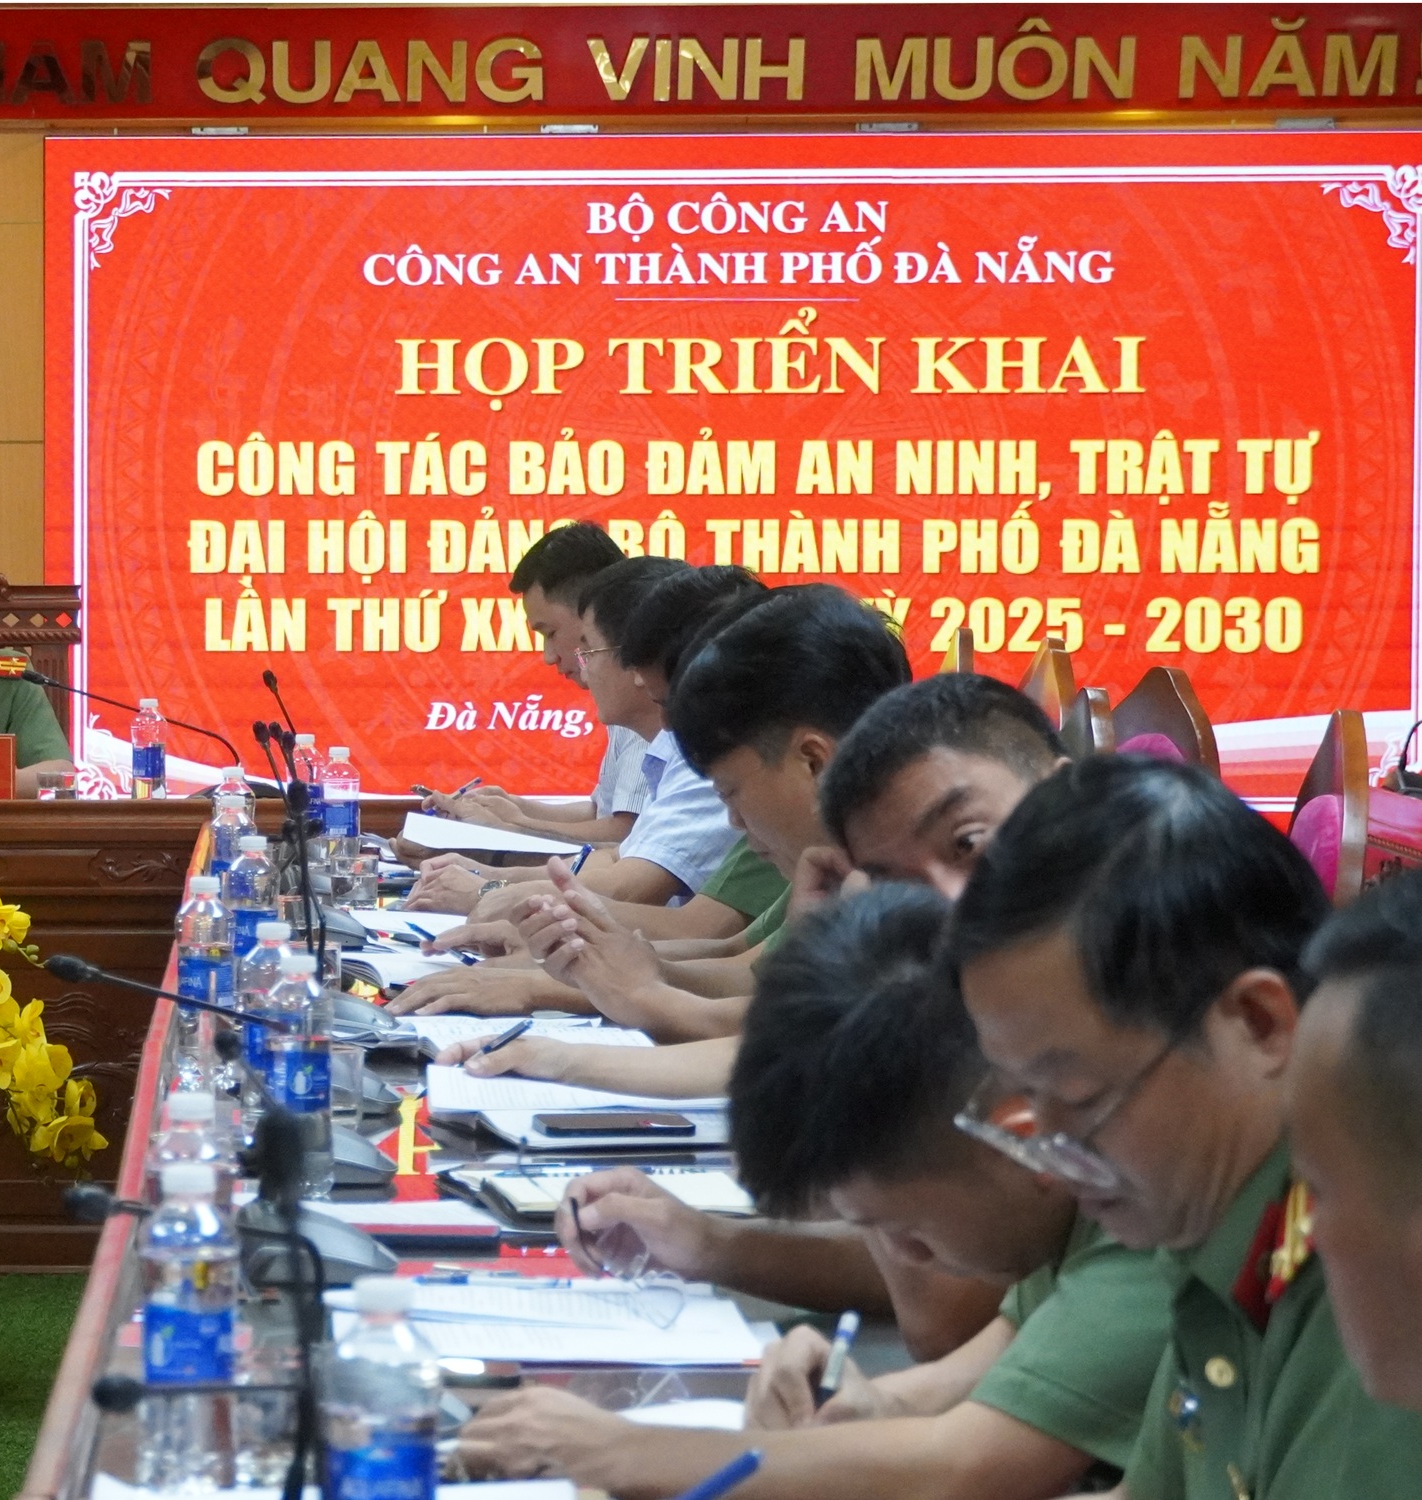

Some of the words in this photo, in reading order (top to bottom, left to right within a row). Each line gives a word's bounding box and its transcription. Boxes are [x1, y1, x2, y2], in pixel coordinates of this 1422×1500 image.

[195, 37, 544, 104] QUANG
[587, 36, 805, 102] VINH
[854, 17, 1137, 102] MUÔN
[1178, 16, 1399, 98] NĂM
[586, 191, 655, 246] BỘ
[667, 191, 809, 234] CÔNG
[819, 200, 889, 233] AN
[363, 243, 503, 286] CÔNG
[514, 252, 583, 285] AN
[594, 242, 768, 285] THÀNH
[778, 236, 883, 284] PHỐ
[893, 241, 962, 284] ĐÀ
[974, 235, 1115, 284] NẴNG
[394, 337, 585, 411] HỌP
[608, 305, 886, 395] TRIỂN
[910, 335, 1146, 394] KHAI
[196, 431, 356, 497] CÔNG
[375, 431, 487, 497] TÁC
[508, 426, 625, 496] BẢO
[644, 426, 776, 495] ĐẢM
[795, 439, 873, 495] AN
[895, 439, 1052, 506] NINH,
[1069, 430, 1220, 507] TRẬT
[1235, 430, 1321, 507] TỰ
[186, 519, 285, 585] ĐẠI
[307, 509, 407, 586] HỘI
[426, 505, 578, 574] ĐẢN
[705, 509, 900, 574] THÀNH
[922, 500, 1040, 575] PHỐ
[1059, 509, 1141, 574] ĐÀ
[1158, 500, 1320, 575] NẴNG
[204, 577, 307, 652] LẦN
[326, 584, 449, 653] THỨ
[930, 596, 1084, 653] 2025
[1103, 623, 1126, 636] -
[1145, 596, 1303, 654] 2030
[424, 701, 478, 731] Đà
[487, 694, 594, 739] Nẵng,
